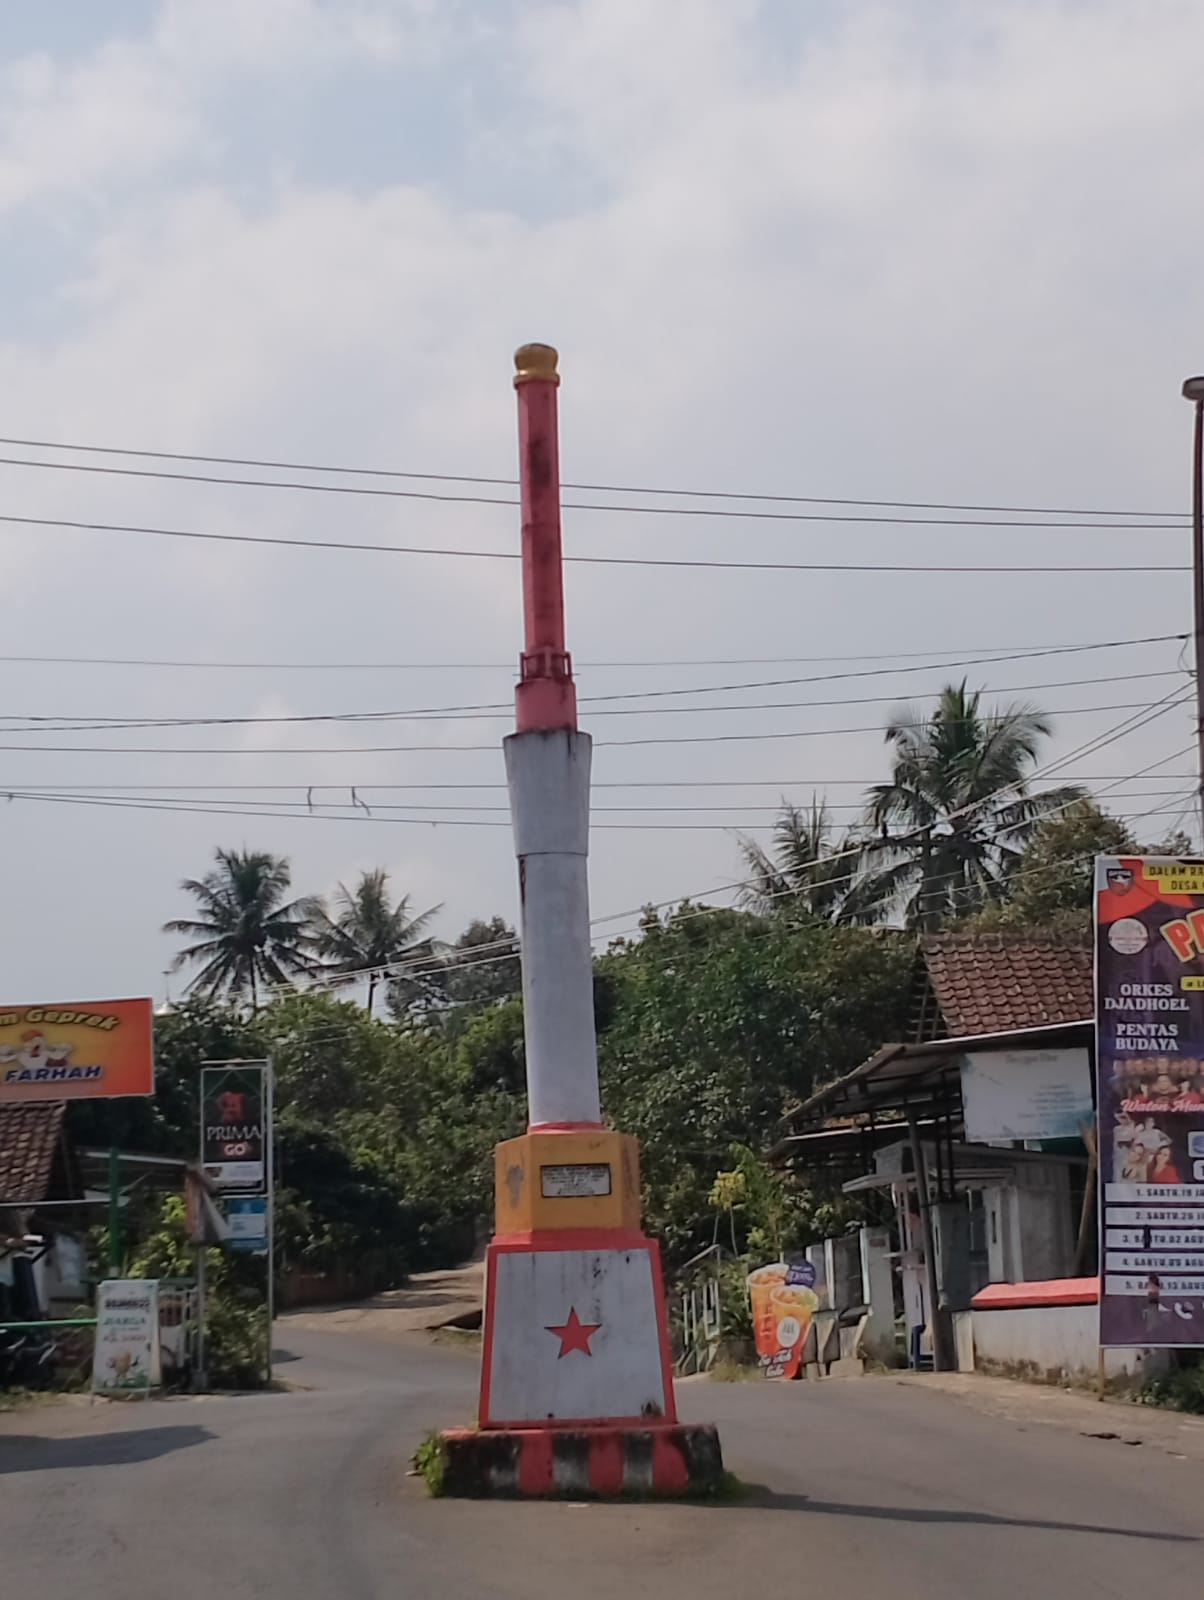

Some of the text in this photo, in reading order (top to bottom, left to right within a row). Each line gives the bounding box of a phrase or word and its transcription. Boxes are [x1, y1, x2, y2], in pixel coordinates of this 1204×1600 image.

[1149, 867, 1185, 876] DALAM
[1171, 881, 1197, 890] DESA
[1121, 984, 1173, 996] ORKES
[1104, 997, 1190, 1010] DJADHOEL
[25, 1007, 120, 1031] Geprek
[1117, 1024, 1178, 1036] PENTAS
[1116, 1038, 1179, 1050] BUDAYA
[6, 1065, 101, 1081] FARHAH
[206, 1125, 260, 1141] PRIMA
[223, 1143, 247, 1156] GO
